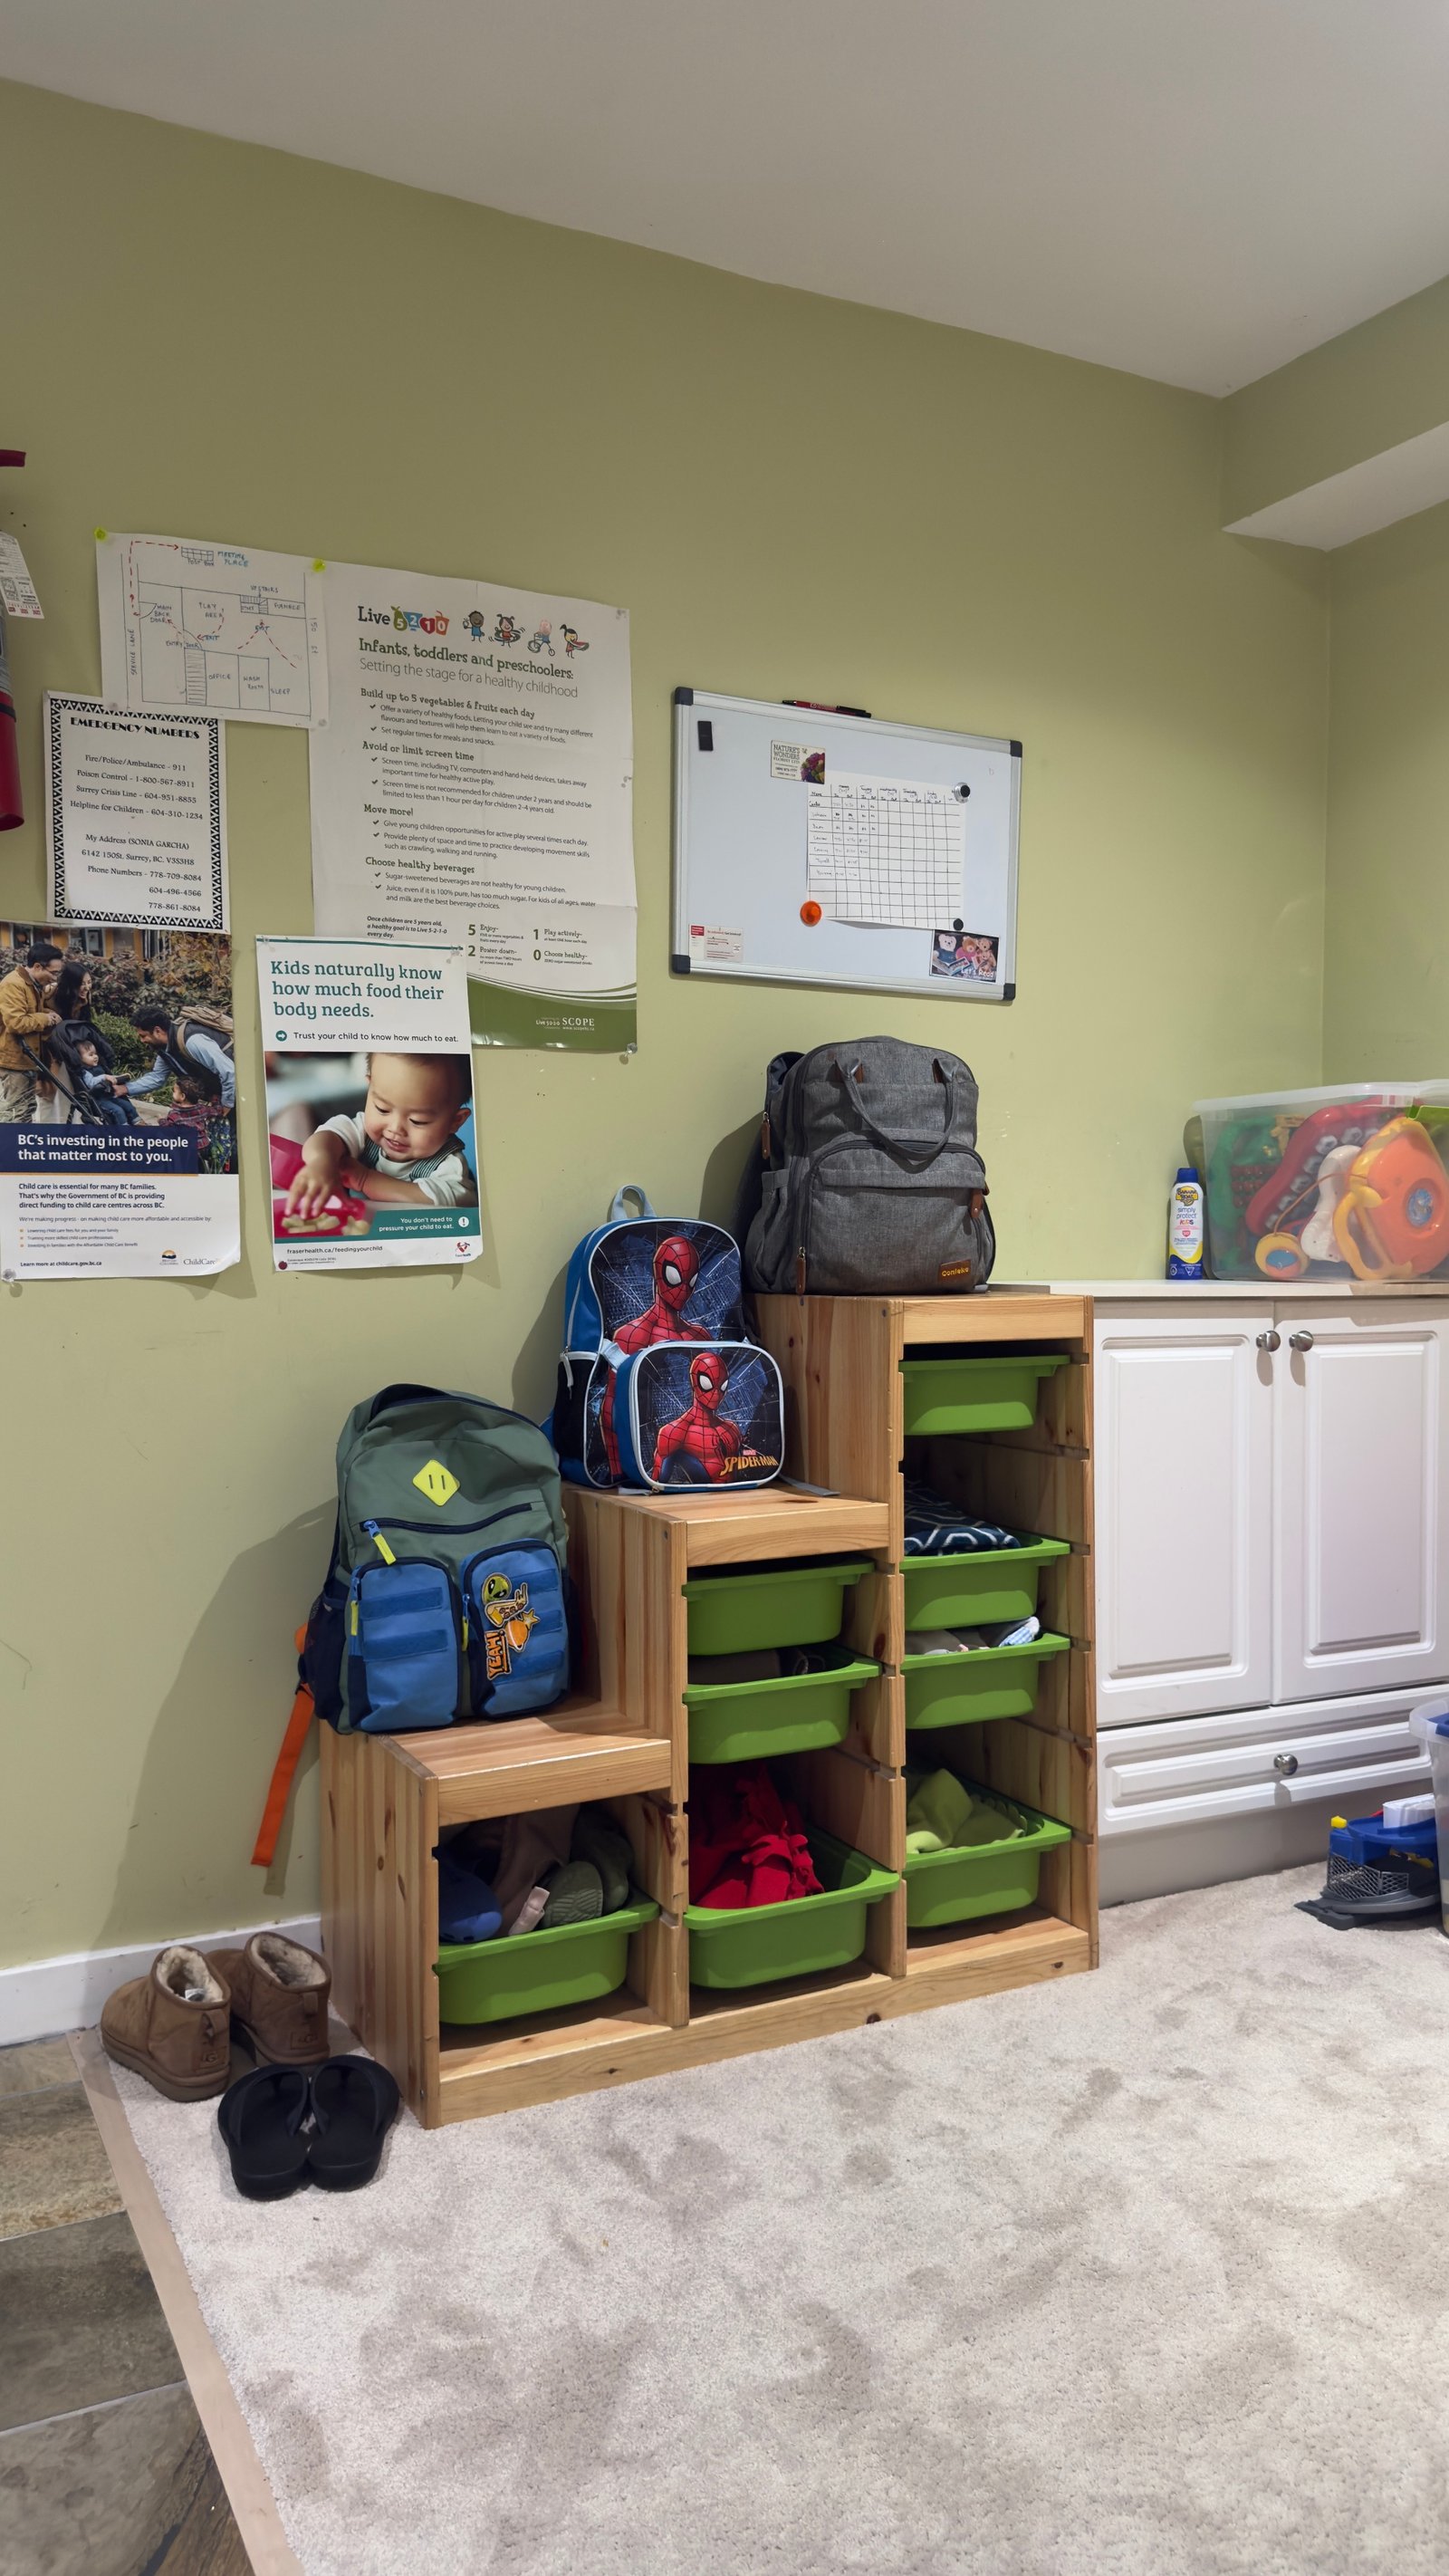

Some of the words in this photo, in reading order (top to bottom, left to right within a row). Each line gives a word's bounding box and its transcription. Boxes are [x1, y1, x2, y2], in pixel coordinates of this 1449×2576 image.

[358, 606, 390, 626] Live
[359, 638, 410, 656] Infants,
[413, 645, 468, 662] toddlers
[470, 654, 493, 667] and
[496, 660, 573, 678] preschoolers:
[359, 657, 400, 676] Setting
[403, 663, 423, 676] the
[425, 668, 456, 682] stage
[458, 668, 474, 681] for
[484, 673, 524, 691] healthy
[525, 680, 578, 697] childhood
[360, 688, 383, 698] Build
[419, 697, 464, 707] vegetables
[474, 701, 498, 712] fruits
[499, 706, 518, 715] each
[520, 708, 535, 720] day
[70, 717, 142, 731] EMERGENCY
[144, 726, 199, 738] NUMBERS
[362, 741, 388, 751] Avoid
[402, 744, 423, 755] limit
[425, 750, 453, 758] screen
[454, 751, 474, 760] time
[773, 744, 800, 754] NATURE'S
[773, 751, 800, 760] WONDERS
[85, 755, 165, 768] Fire/Police/Ambulance
[77, 769, 99, 777] Poison
[101, 772, 128, 780] Control
[136, 776, 194, 787] 1-800-567-8911
[76, 785, 99, 795] Surrey
[144, 792, 196, 803] 604-951-8855
[70, 800, 99, 809] Helpline
[112, 805, 143, 813] Children
[150, 808, 203, 819] 604-310-1234
[363, 804, 387, 813] Move
[85, 834, 97, 842] My
[125, 853, 151, 862] Surrey,
[365, 856, 395, 866] Choose
[397, 859, 431, 871] healthy
[433, 862, 474, 875] beverages
[149, 871, 201, 880] 778-709-8084
[385, 872, 438, 882] Sugar-sweetened
[439, 877, 470, 885] beverages
[492, 881, 513, 889] healthy
[148, 887, 201, 896] 604-496-4566
[148, 902, 200, 911] 778-861-8084
[468, 924, 476, 935] 5
[533, 929, 538, 940] 1
[468, 946, 476, 956] 2
[533, 949, 541, 960] 0
[270, 960, 310, 974] Kids
[314, 963, 394, 980] naturally
[398, 965, 442, 979] know
[961, 967, 976, 975] Let's
[272, 981, 310, 995] how
[314, 983, 362, 996] much
[366, 983, 401, 998] food
[404, 985, 444, 999] their
[274, 1001, 316, 1019] body
[321, 1003, 373, 1017] needs.
[562, 1017, 594, 1026] SCOPE
[17, 1134, 44, 1145] BC's
[46, 1134, 105, 1148] investing
[123, 1136, 144, 1146] the
[147, 1137, 188, 1149] people
[17, 1149, 45, 1159] that
[48, 1151, 92, 1160] matter
[95, 1151, 127, 1160] most
[129, 1151, 143, 1161] to
[145, 1153, 172, 1164] you.
[487, 1631, 504, 1678] YEAH!
